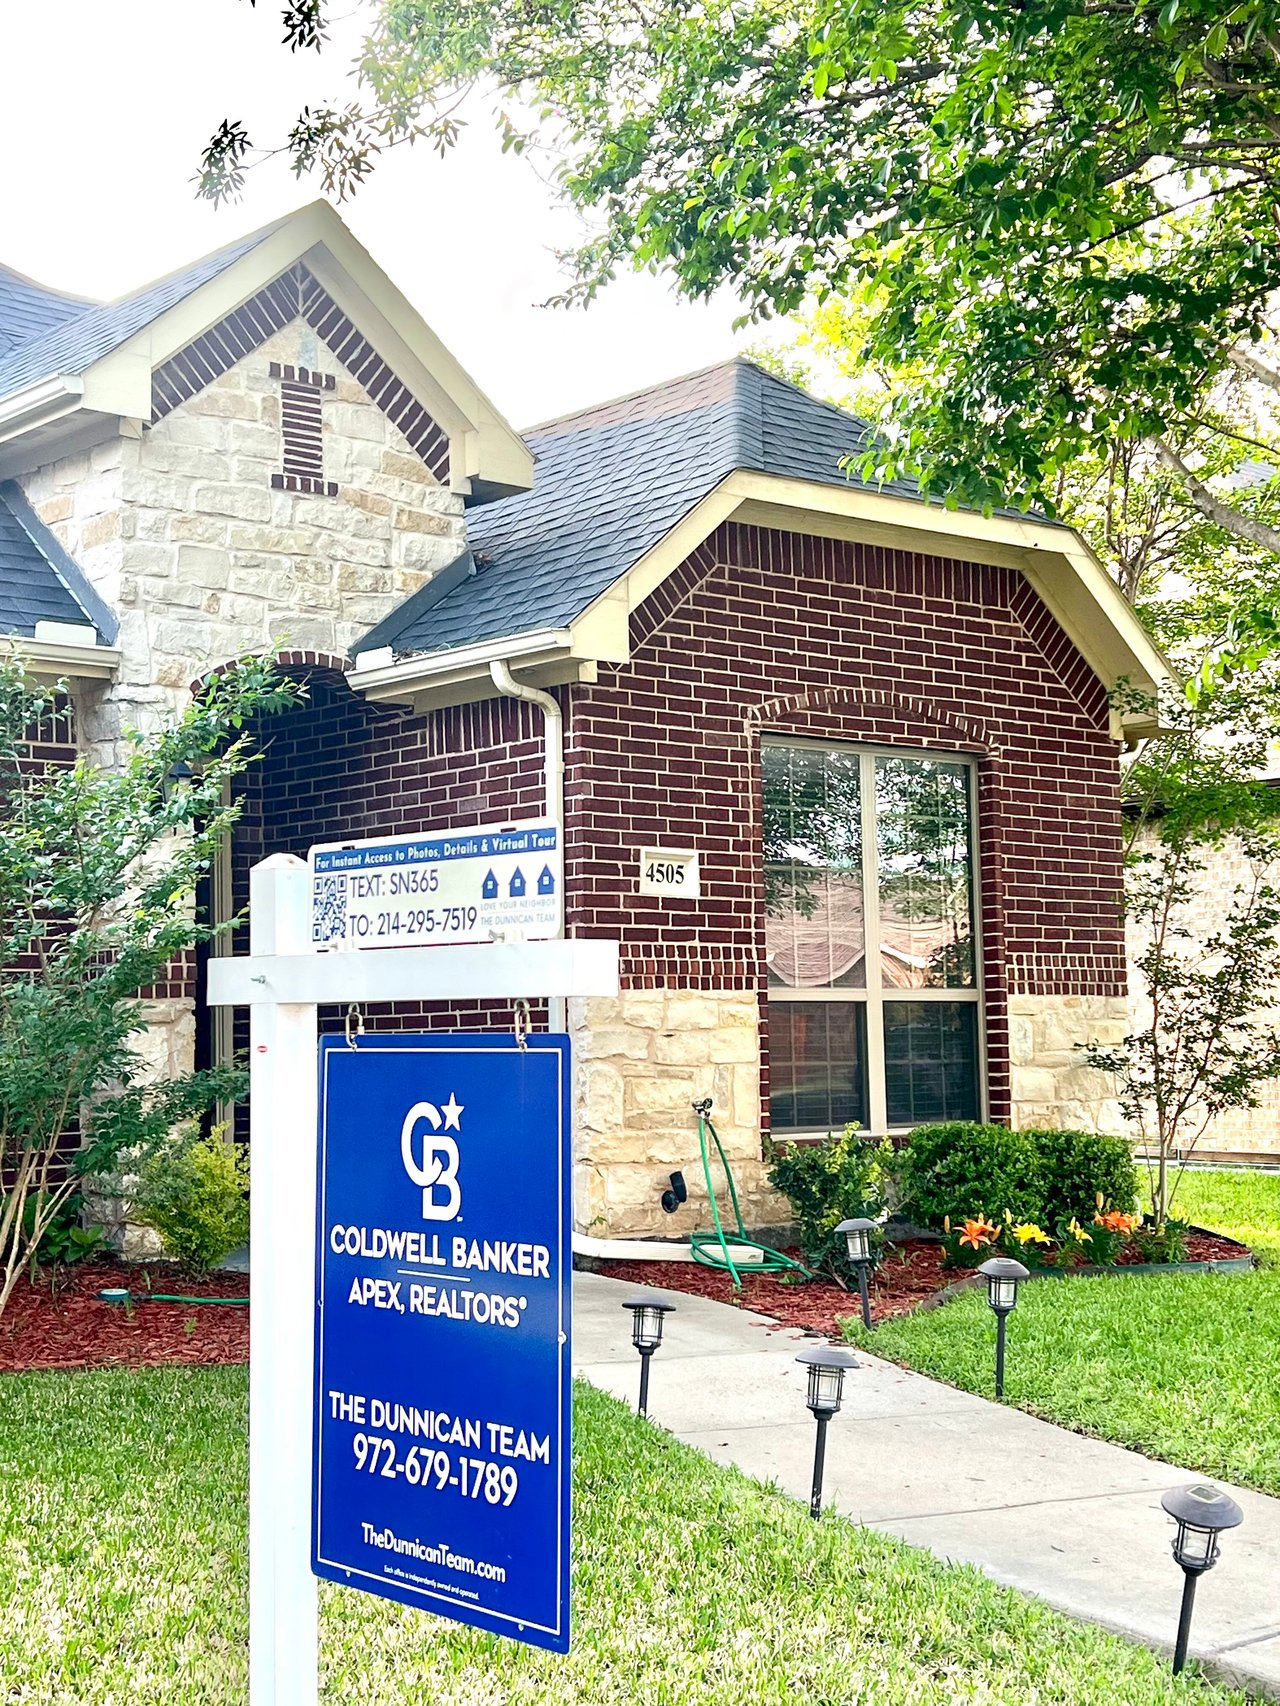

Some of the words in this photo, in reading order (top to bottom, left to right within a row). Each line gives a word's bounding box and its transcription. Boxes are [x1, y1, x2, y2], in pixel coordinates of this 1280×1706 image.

[315, 857, 330, 869] For
[332, 854, 362, 868] Instant
[364, 852, 393, 864] Access
[395, 850, 405, 861] to
[407, 846, 441, 860] Photos,
[443, 840, 478, 856] Details
[481, 838, 489, 853] &
[492, 834, 528, 851] Virtual
[531, 833, 556, 848] Tour
[350, 874, 386, 898] TEXT:
[390, 869, 439, 895] SN365
[645, 862, 685, 884] 4505
[350, 915, 373, 937] TO:
[377, 906, 478, 936] 214-295-7519
[480, 902, 497, 911] LOVE
[499, 900, 517, 910] YOUR
[519, 898, 556, 908] NEIGHBOR
[480, 916, 493, 926] THE
[495, 914, 534, 925] DUNNICAN
[536, 913, 556, 922] TEAM
[401, 1101, 462, 1221] CB
[330, 1224, 447, 1266] COLDWELL
[452, 1236, 550, 1278] BANKER
[348, 1276, 405, 1314] APEX,
[329, 1390, 366, 1424] THE
[371, 1399, 481, 1449] DUNNICAN
[486, 1422, 550, 1464] TEAM
[353, 1432, 518, 1507] 972-679-1789
[361, 1522, 506, 1583] TheDunnicanTeam.com
